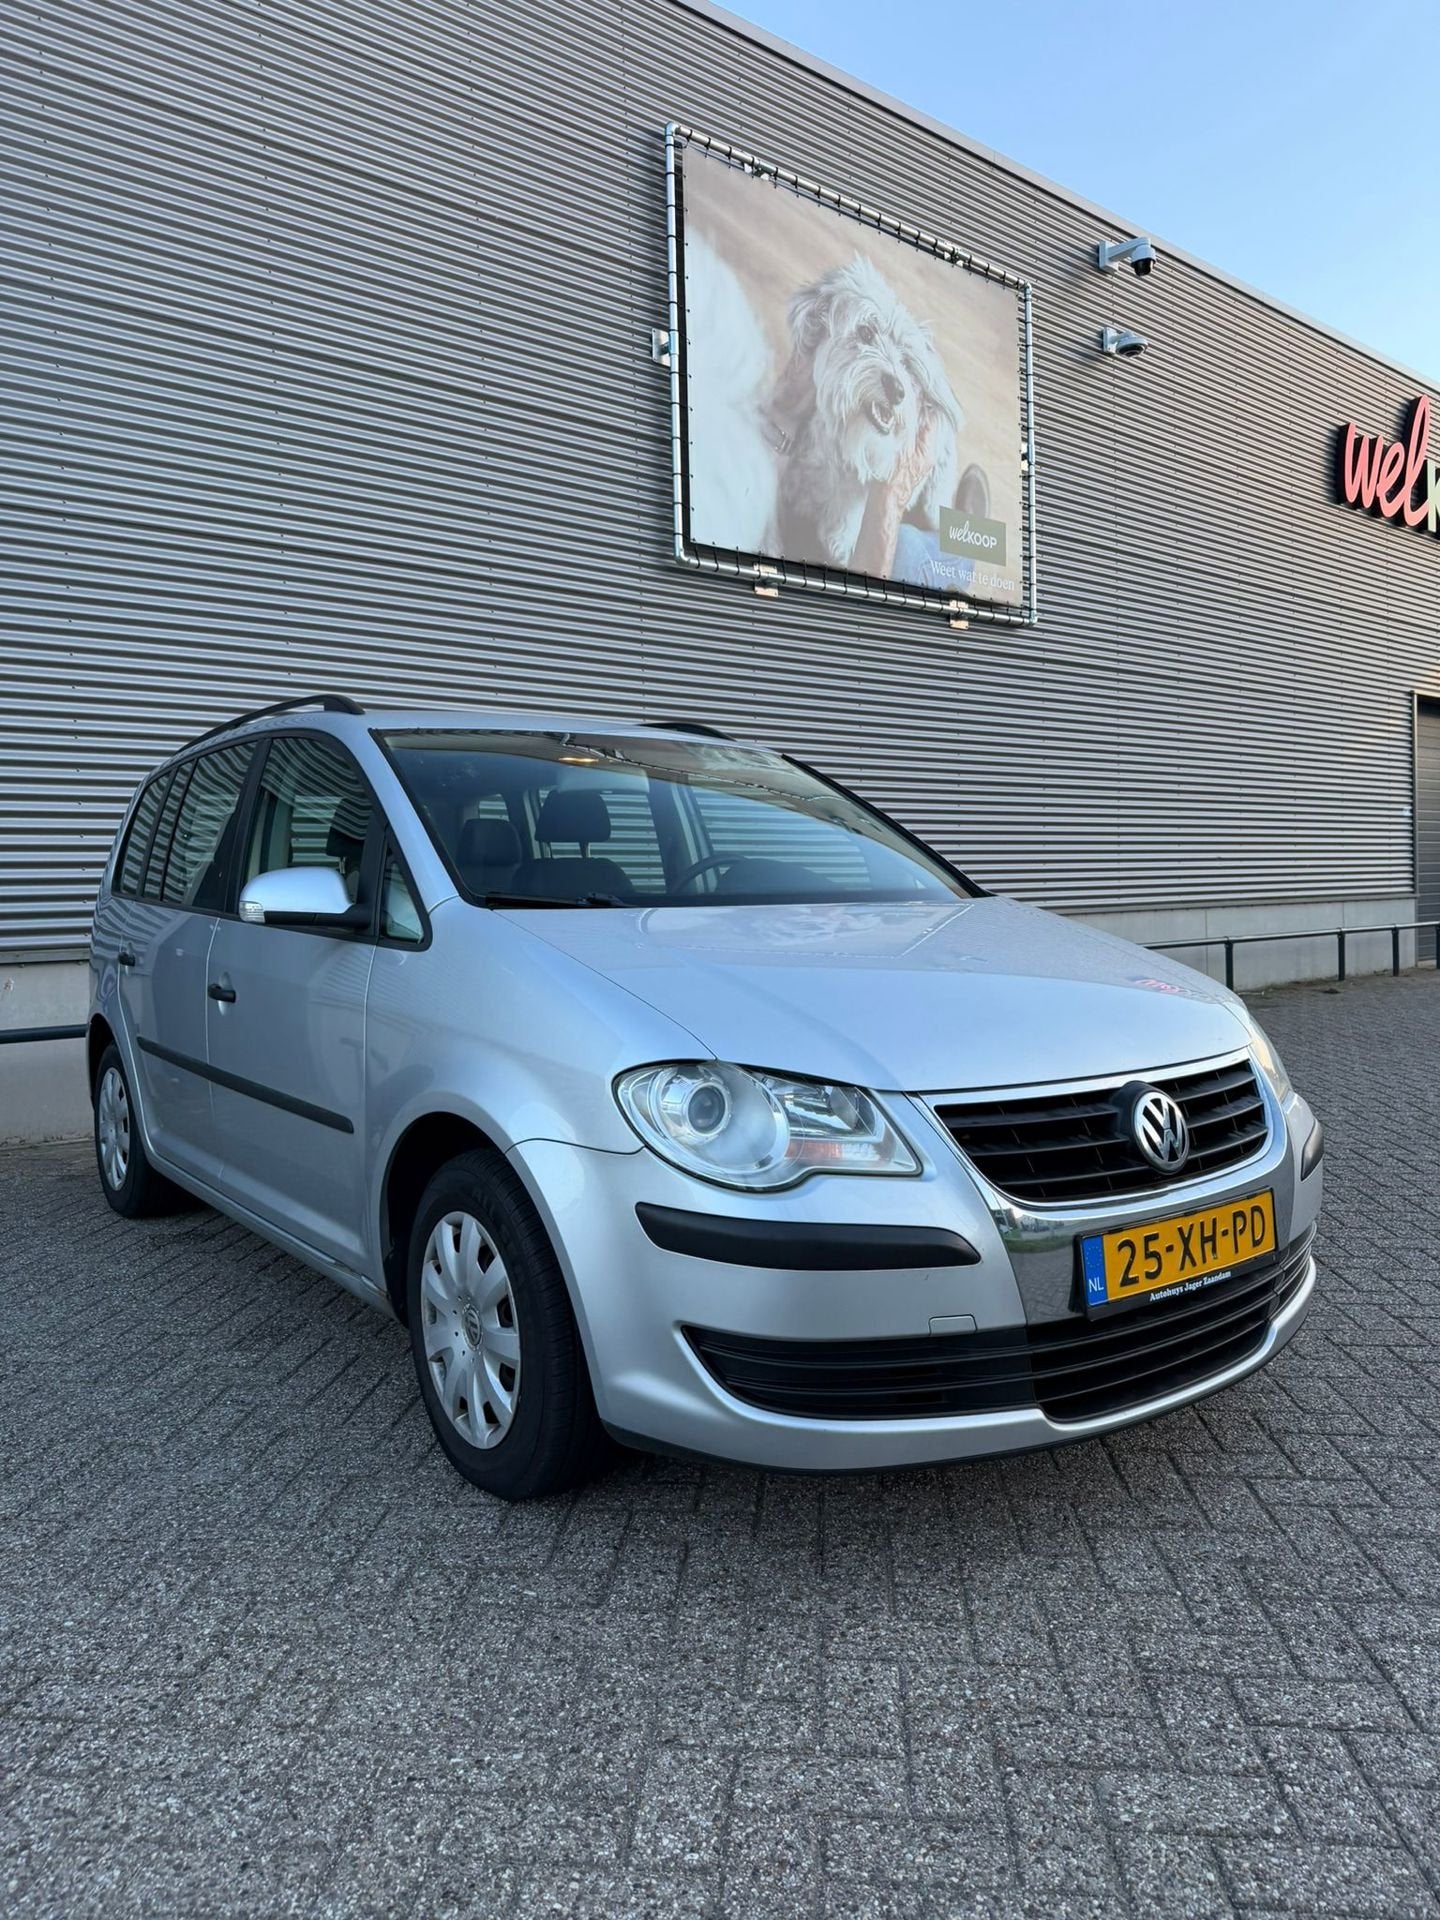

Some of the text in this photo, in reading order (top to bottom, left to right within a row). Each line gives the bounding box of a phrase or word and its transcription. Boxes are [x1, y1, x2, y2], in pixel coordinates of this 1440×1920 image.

[931, 560, 1015, 591] Weet wat te doen
[1088, 1205, 1266, 1293] NL 25-XH-PD
[1150, 1270, 1232, 1302] Autohuys Jager Zaandam
